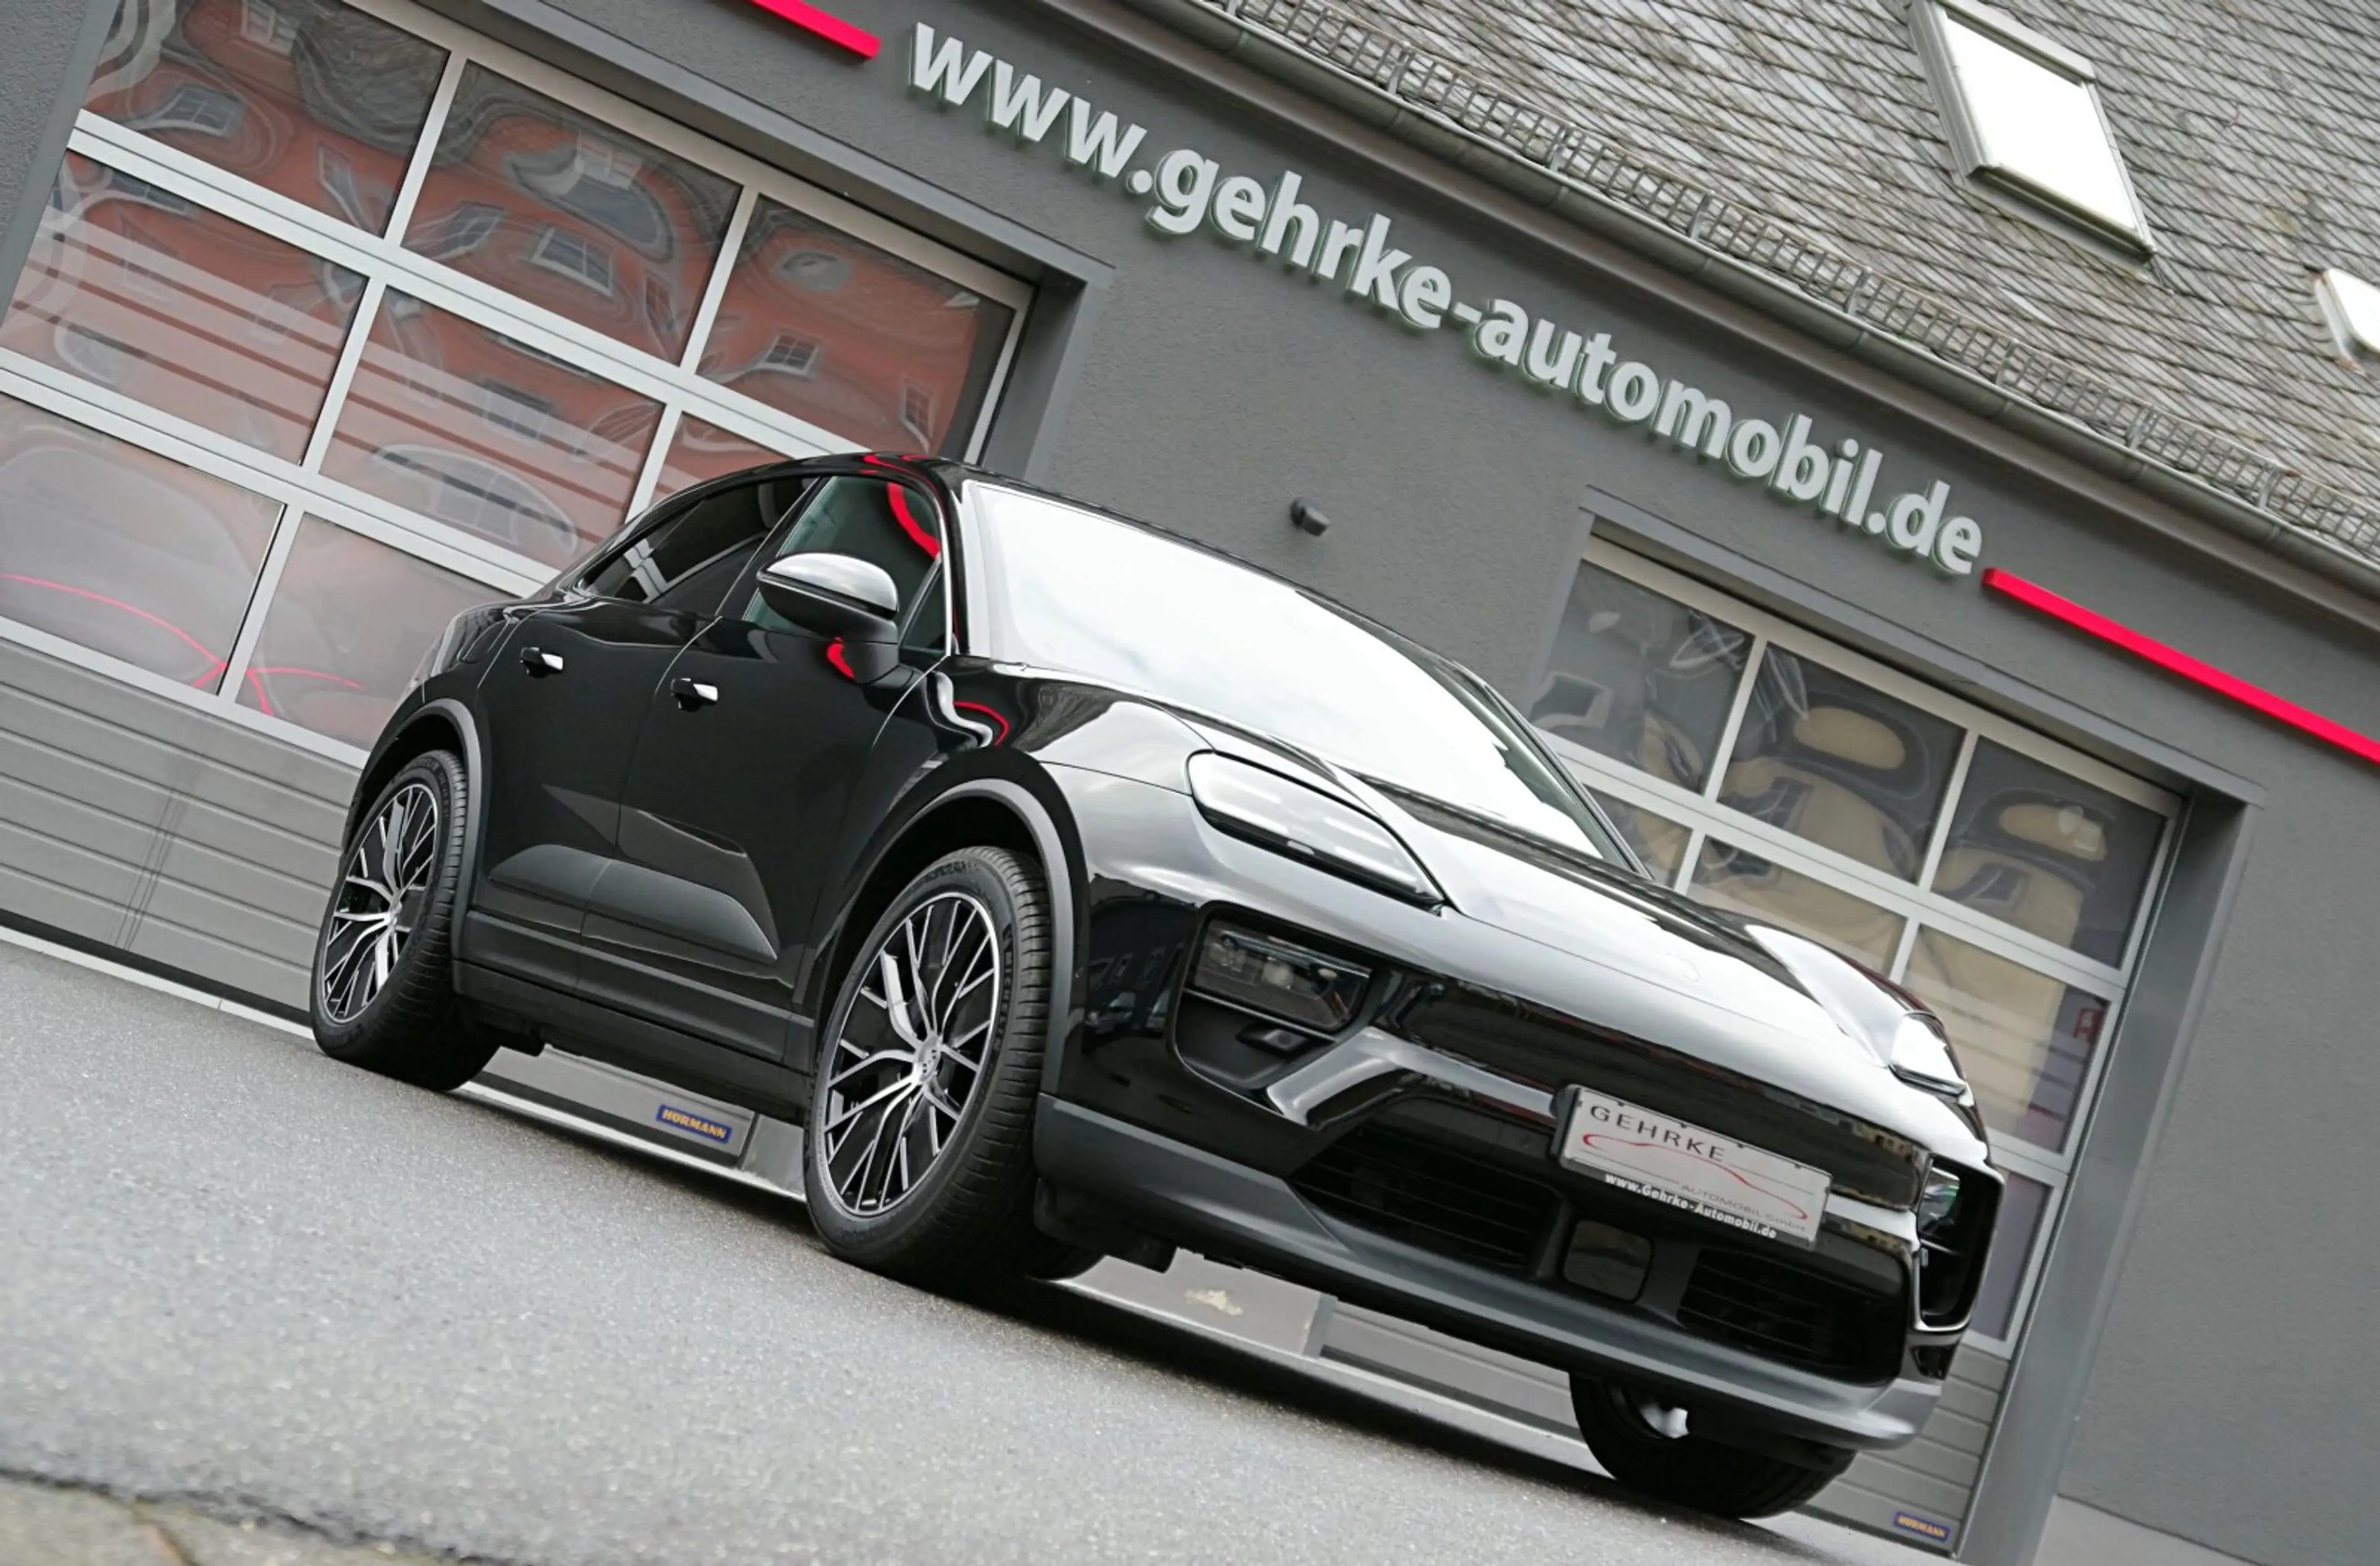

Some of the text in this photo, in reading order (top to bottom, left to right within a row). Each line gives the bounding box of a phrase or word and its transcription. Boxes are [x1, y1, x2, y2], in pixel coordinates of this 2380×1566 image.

[911, 20, 1983, 575] www.gehrke-automobil.de
[1590, 1106, 1725, 1162] GEHRKE
[1605, 1174, 1777, 1239] www.Gehrke-Automobil.de
[1681, 1184, 1761, 1217] AUTOMOBIL
